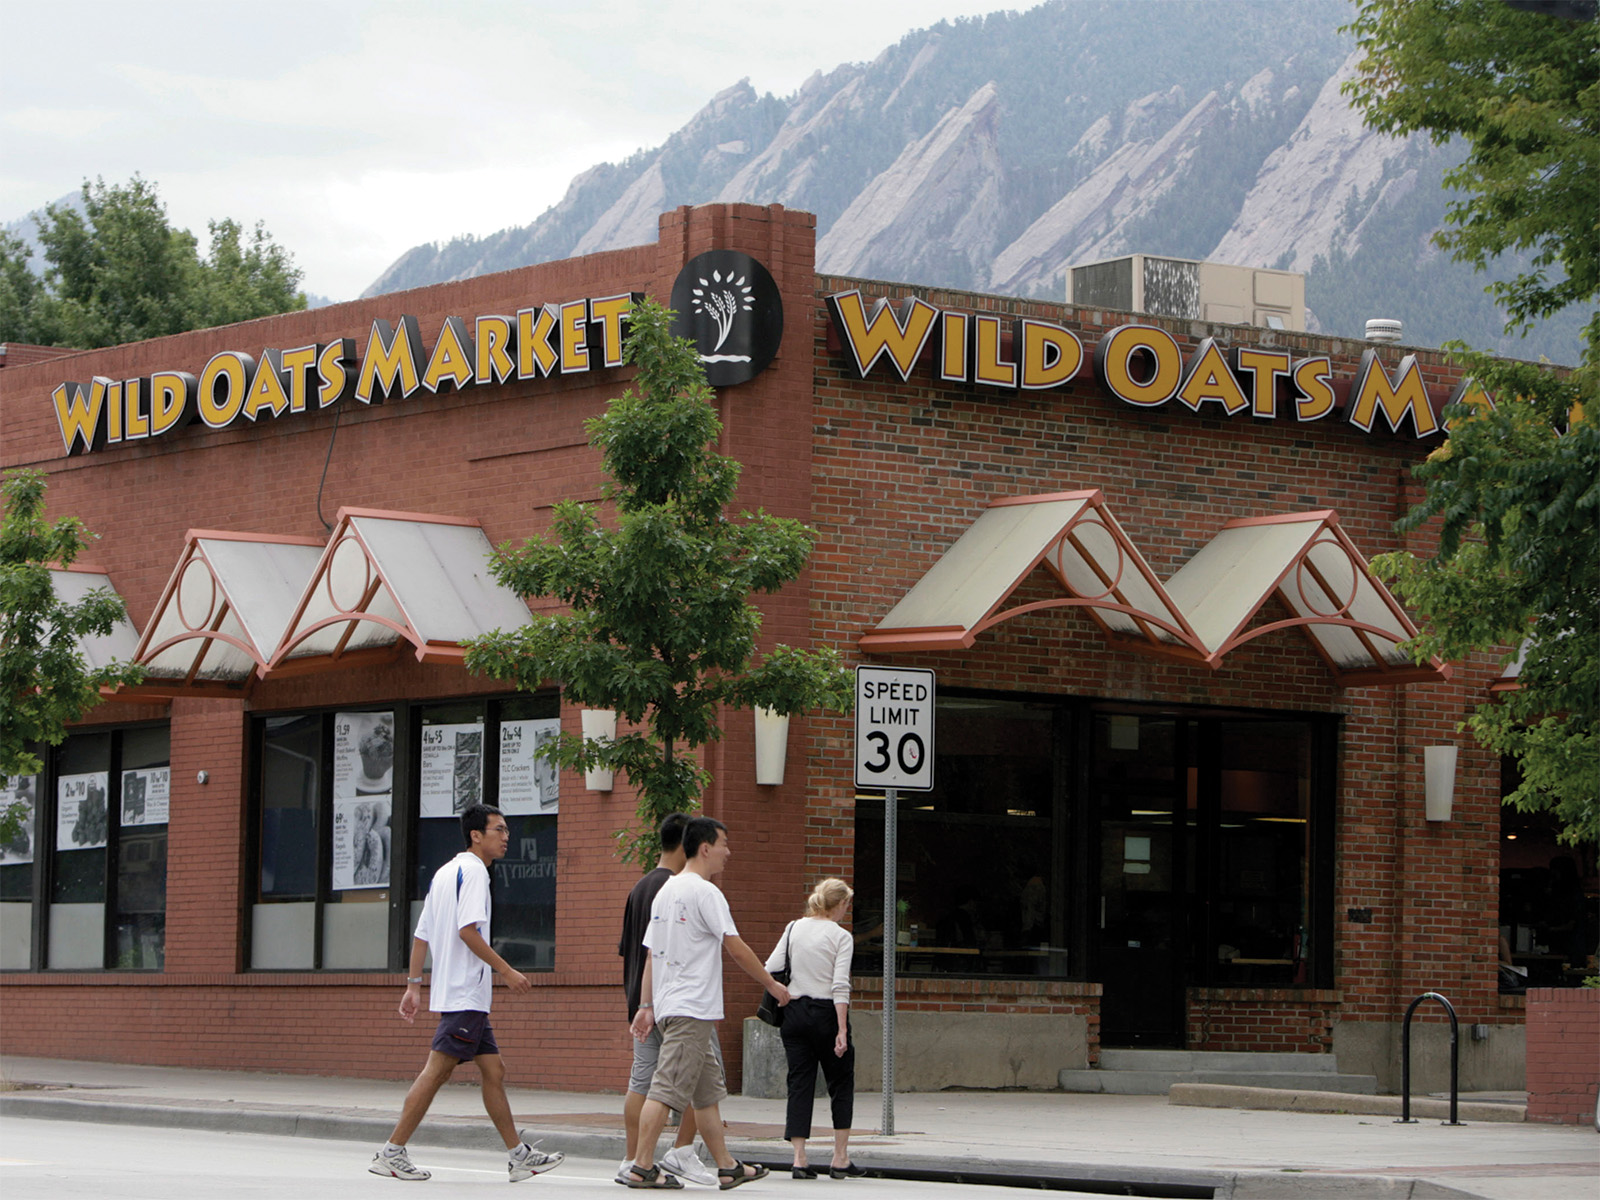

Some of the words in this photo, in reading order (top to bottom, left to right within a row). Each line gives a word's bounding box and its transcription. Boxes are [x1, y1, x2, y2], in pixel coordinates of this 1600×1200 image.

[827, 289, 1084, 391] WILD
[1101, 323, 1334, 422] OATS
[51, 375, 189, 455] WILD
[196, 338, 348, 429] OATS
[354, 292, 635, 405] MARKET
[863, 681, 928, 702] SPEED
[870, 706, 920, 726] LIMIT
[422, 730, 428, 744] 4
[434, 730, 443, 743] $5
[502, 727, 507, 741] 2
[513, 726, 522, 740] $4
[863, 730, 925, 775] 30
[65, 782, 70, 797] 2
[75, 781, 85, 796] $10
